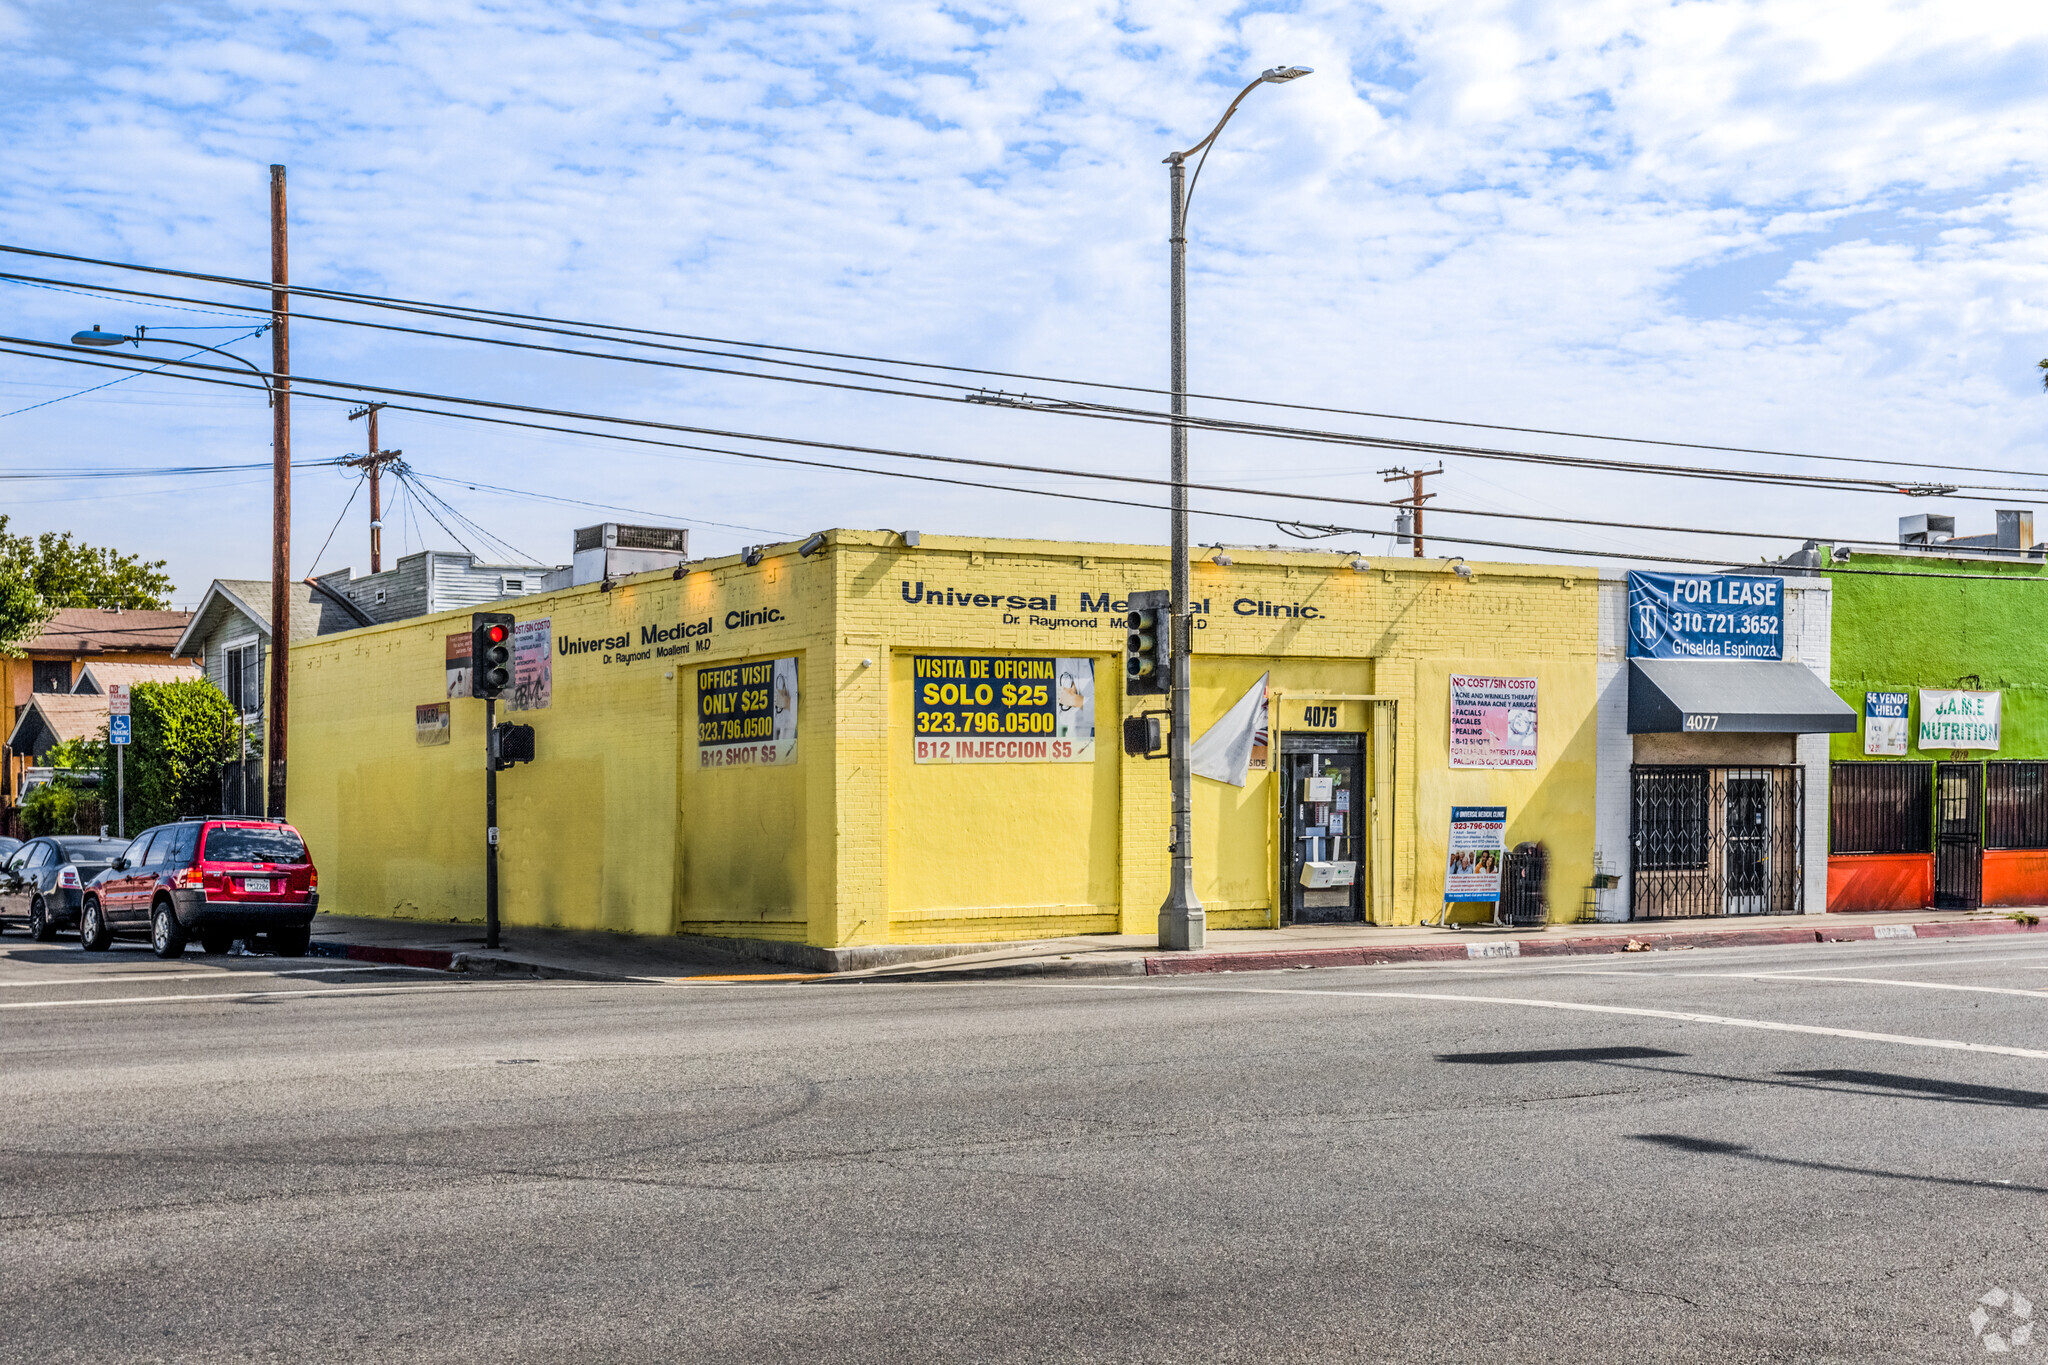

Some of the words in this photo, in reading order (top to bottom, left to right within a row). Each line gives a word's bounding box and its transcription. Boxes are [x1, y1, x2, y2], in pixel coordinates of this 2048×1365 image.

[902, 582, 1056, 611] Universal
[1080, 592, 1210, 614] Meal
[1233, 598, 1325, 618] Clinic.
[1673, 580, 1712, 603] FOR
[1718, 582, 1776, 606] LEASE
[534, 620, 550, 631] COSTO
[558, 632, 630, 656] Universal
[641, 617, 712, 645] Medical
[725, 607, 784, 630] Clinic.
[1003, 614, 1020, 624] Dr.
[1030, 615, 1097, 630] Raymond
[1672, 612, 1778, 634] 310.721.3652
[603, 654, 612, 664] Dr.
[616, 651, 650, 666] Raymond
[656, 642, 690, 658] Moallemi
[1672, 639, 1720, 656] Griselda
[1724, 641, 1776, 658] Espinoza
[700, 669, 738, 690] OFFICE
[742, 664, 772, 686] VISIT
[916, 659, 965, 678] VISITA
[970, 660, 990, 678] DE
[994, 660, 1054, 680] OFICINA
[1452, 678, 1466, 687] NO
[1508, 680, 1536, 689] COSTO
[703, 692, 738, 716] ONLY
[742, 689, 768, 714] $25
[923, 683, 994, 706] SOLO
[1001, 682, 1048, 708] $25
[1867, 692, 1877, 704] SE
[1879, 693, 1908, 704] VENDE
[416, 708, 440, 724] VIAGRA
[1304, 706, 1337, 728] 4075
[1876, 704, 1902, 716] HIELO
[699, 716, 772, 741] 323.796.0500
[917, 712, 1054, 733] 323.796.0500
[1686, 715, 1718, 730] 4077
[1921, 721, 1998, 741] NUTRITION
[702, 750, 722, 768] B12
[726, 746, 758, 766] SHOT
[761, 744, 776, 764] $5
[918, 741, 950, 758] B12
[956, 741, 1046, 758] INJECCION
[1052, 740, 1072, 759] $5
